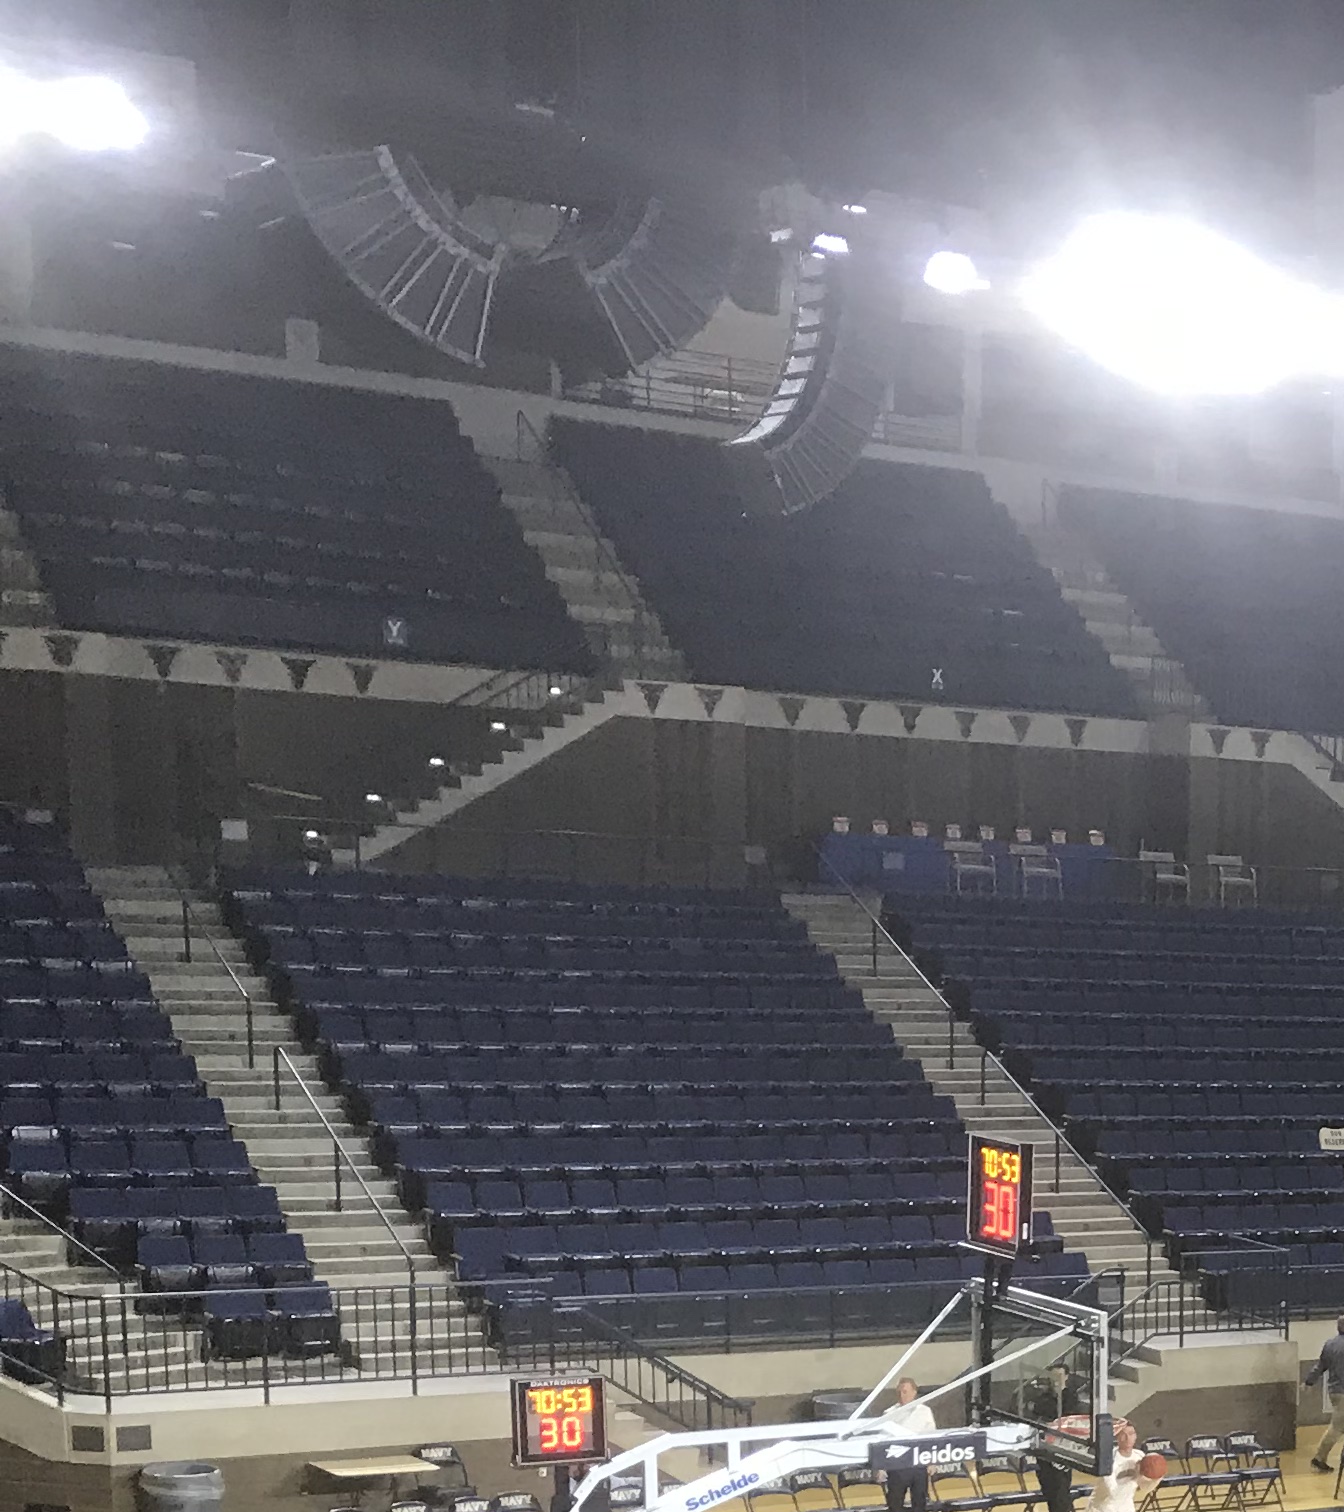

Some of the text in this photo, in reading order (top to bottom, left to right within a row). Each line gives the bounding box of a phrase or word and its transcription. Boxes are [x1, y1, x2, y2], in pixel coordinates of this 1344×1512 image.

[387, 620, 402, 637] Y
[981, 1147, 1020, 1183] 70:53
[983, 1181, 1015, 1238] 30
[530, 1378, 590, 1387] DAKTRONICS
[528, 1386, 593, 1414] 70:53
[541, 1416, 582, 1448] 30
[420, 1447, 452, 1460] NAVY
[913, 1443, 976, 1466] leidos
[499, 1494, 533, 1507] NAVY
[685, 1472, 760, 1511] Schelde
[455, 1500, 490, 1512] NAVY
